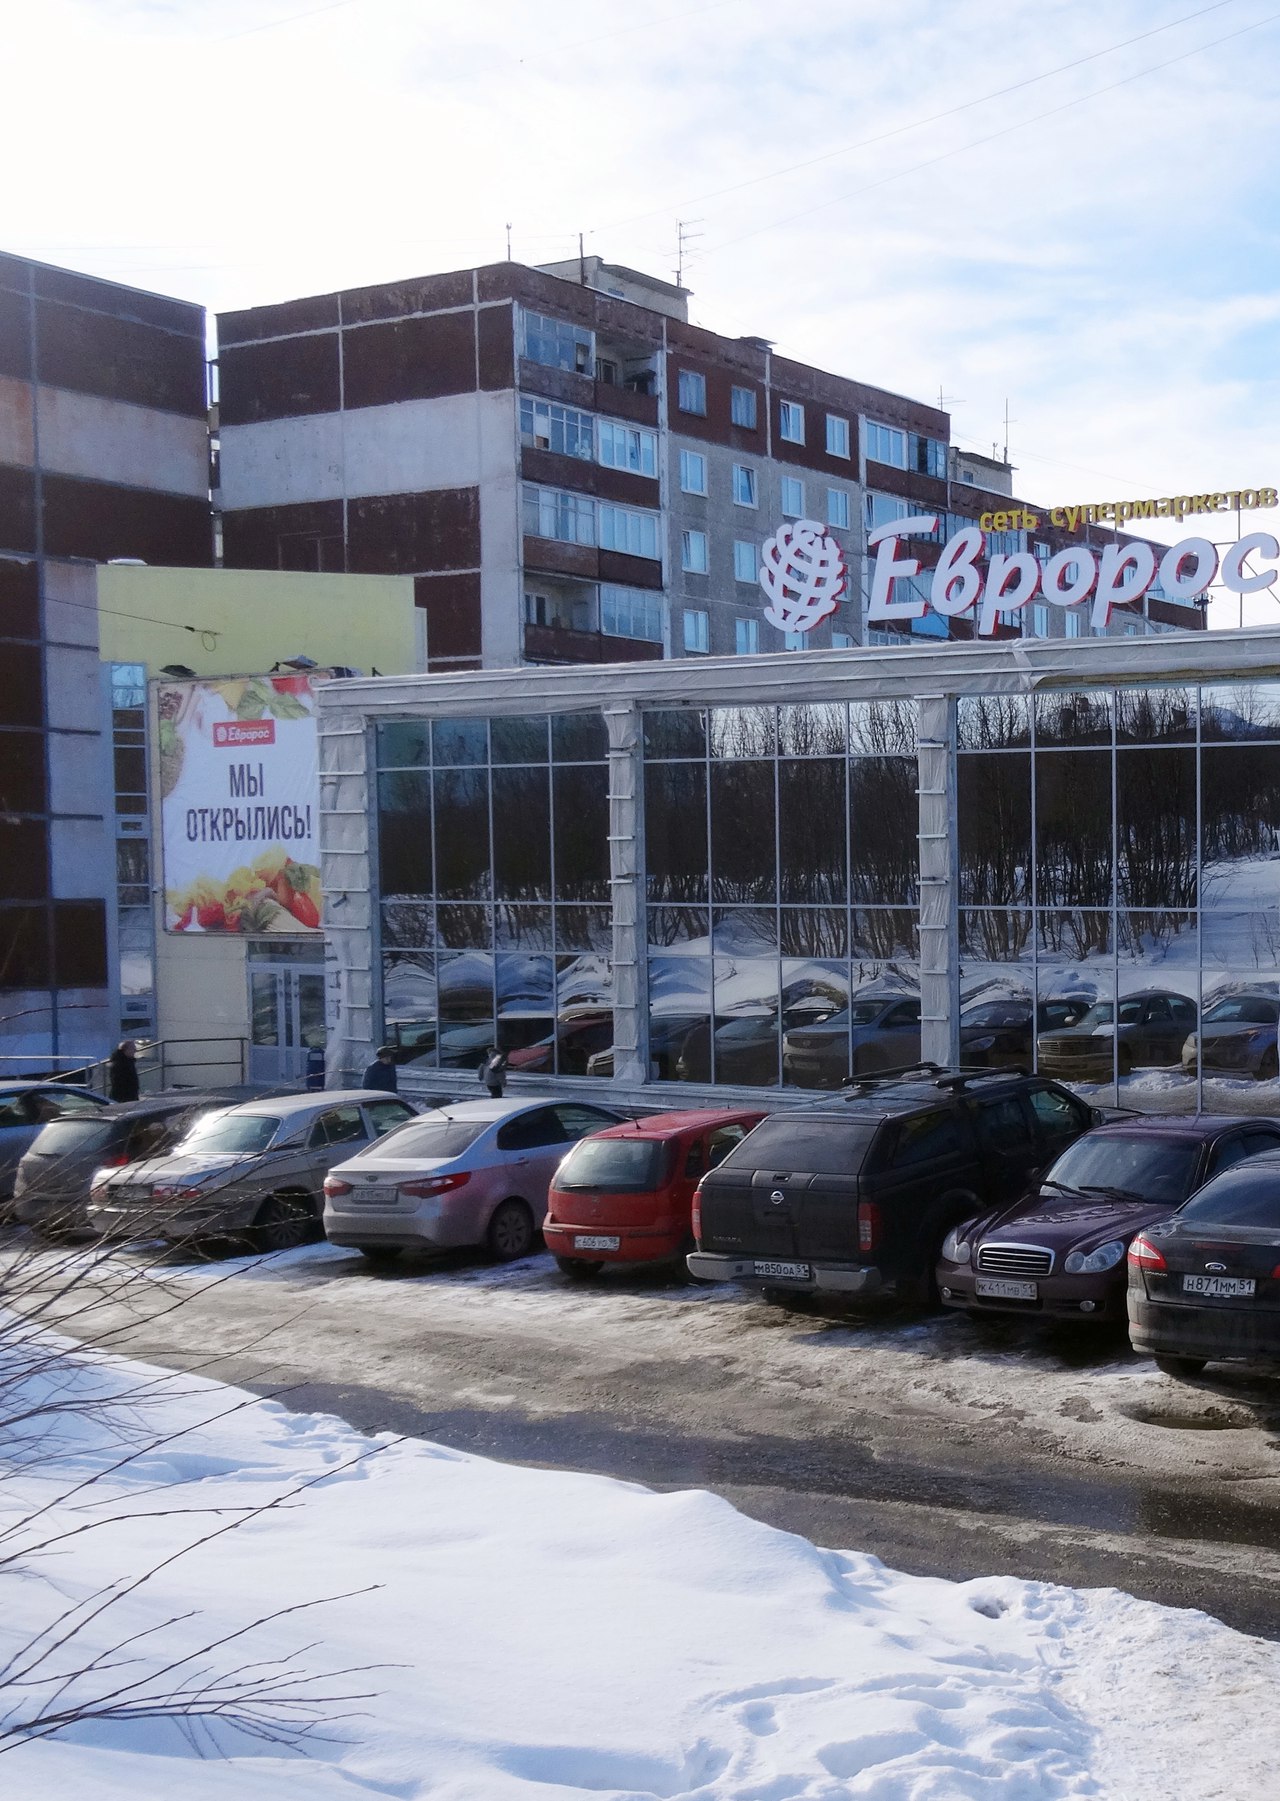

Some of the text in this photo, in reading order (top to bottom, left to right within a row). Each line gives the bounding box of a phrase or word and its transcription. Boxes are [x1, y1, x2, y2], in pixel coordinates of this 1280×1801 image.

[979, 487, 1279, 533] сеть супермаркетов
[868, 516, 1280, 636] Евророс
[227, 726, 270, 743] Евророс
[229, 762, 264, 798] МЫ
[186, 804, 312, 842] ОТКРЫЛИСЬ!
